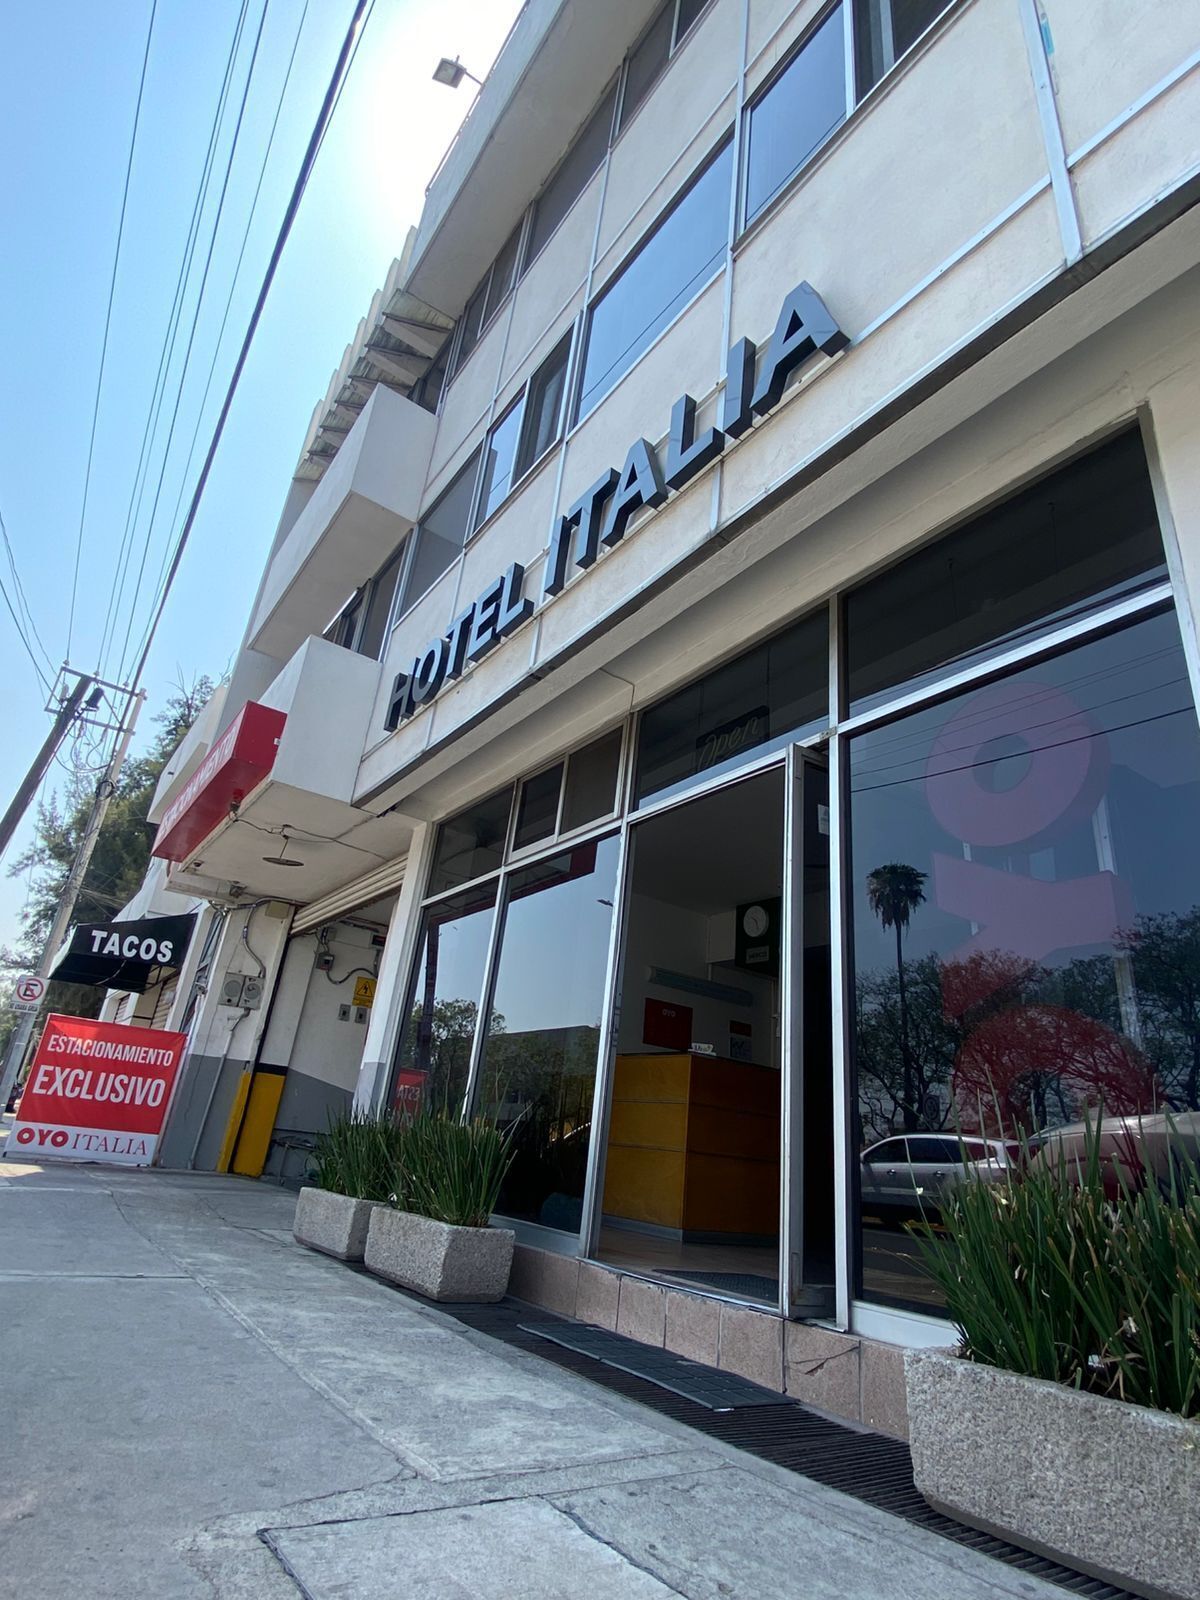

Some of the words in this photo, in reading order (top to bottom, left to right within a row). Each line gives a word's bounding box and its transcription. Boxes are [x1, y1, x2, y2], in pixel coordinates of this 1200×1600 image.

[384, 562, 534, 733] HOTEL
[545, 280, 851, 597] ITALIA
[90, 929, 174, 964] TACOS
[47, 1034, 174, 1067] ESTACIONAMIENTO
[32, 1064, 166, 1107] EXCLUSIVO
[16, 1127, 69, 1149] OYO
[72, 1133, 148, 1156] ITALIA
